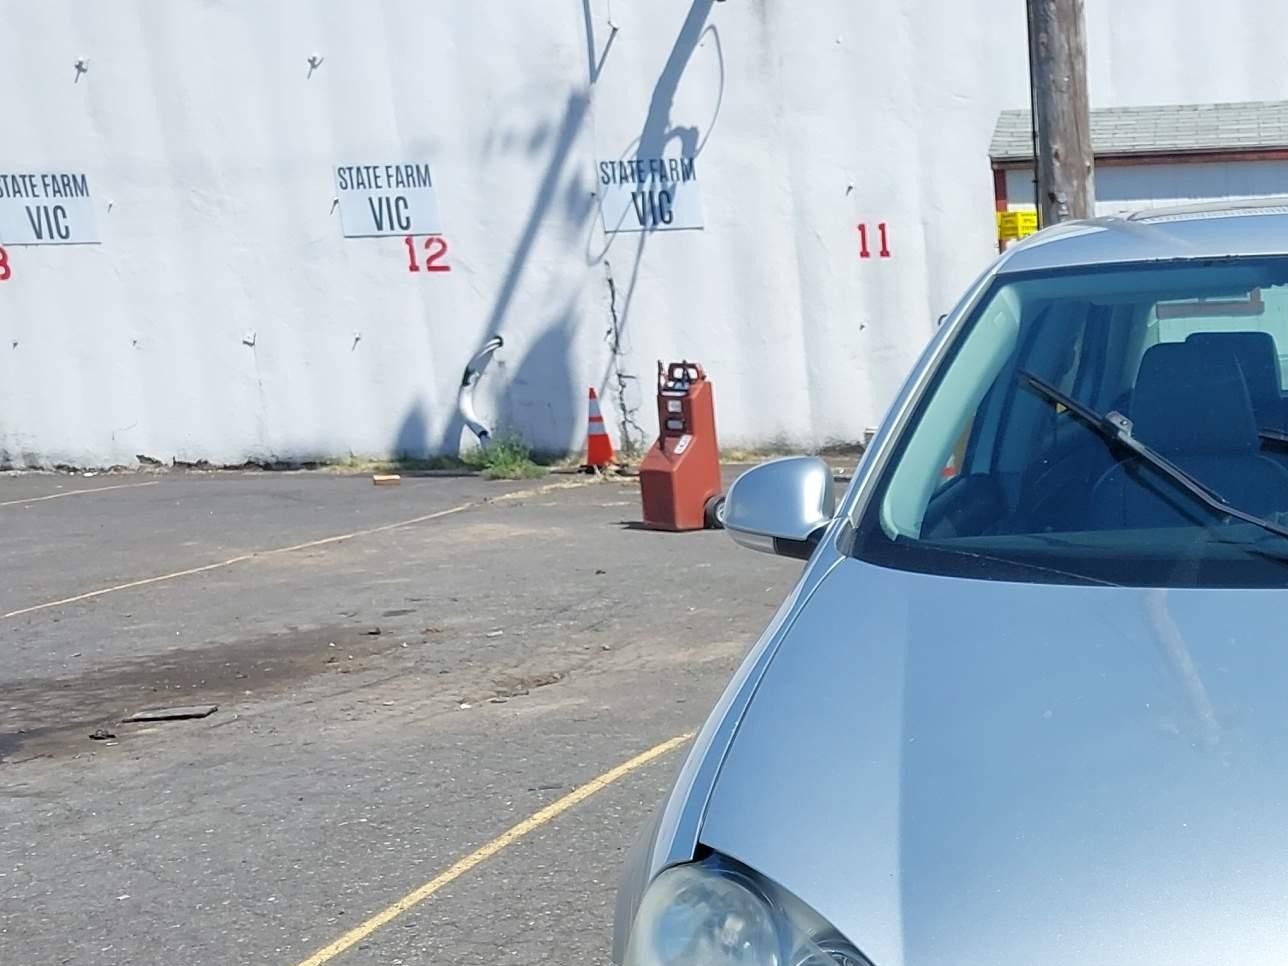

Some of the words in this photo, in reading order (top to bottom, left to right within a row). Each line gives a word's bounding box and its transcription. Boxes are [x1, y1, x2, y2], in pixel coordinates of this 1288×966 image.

[41, 173, 90, 198] FARM
[337, 166, 383, 190] STATE
[385, 164, 432, 188] FARM
[600, 159, 646, 185] STATE
[648, 157, 697, 183] FARM
[25, 204, 71, 240] VIC
[368, 195, 411, 231] VIC
[631, 189, 674, 226] VIC
[405, 236, 451, 272] 12
[857, 222, 891, 258] 11
